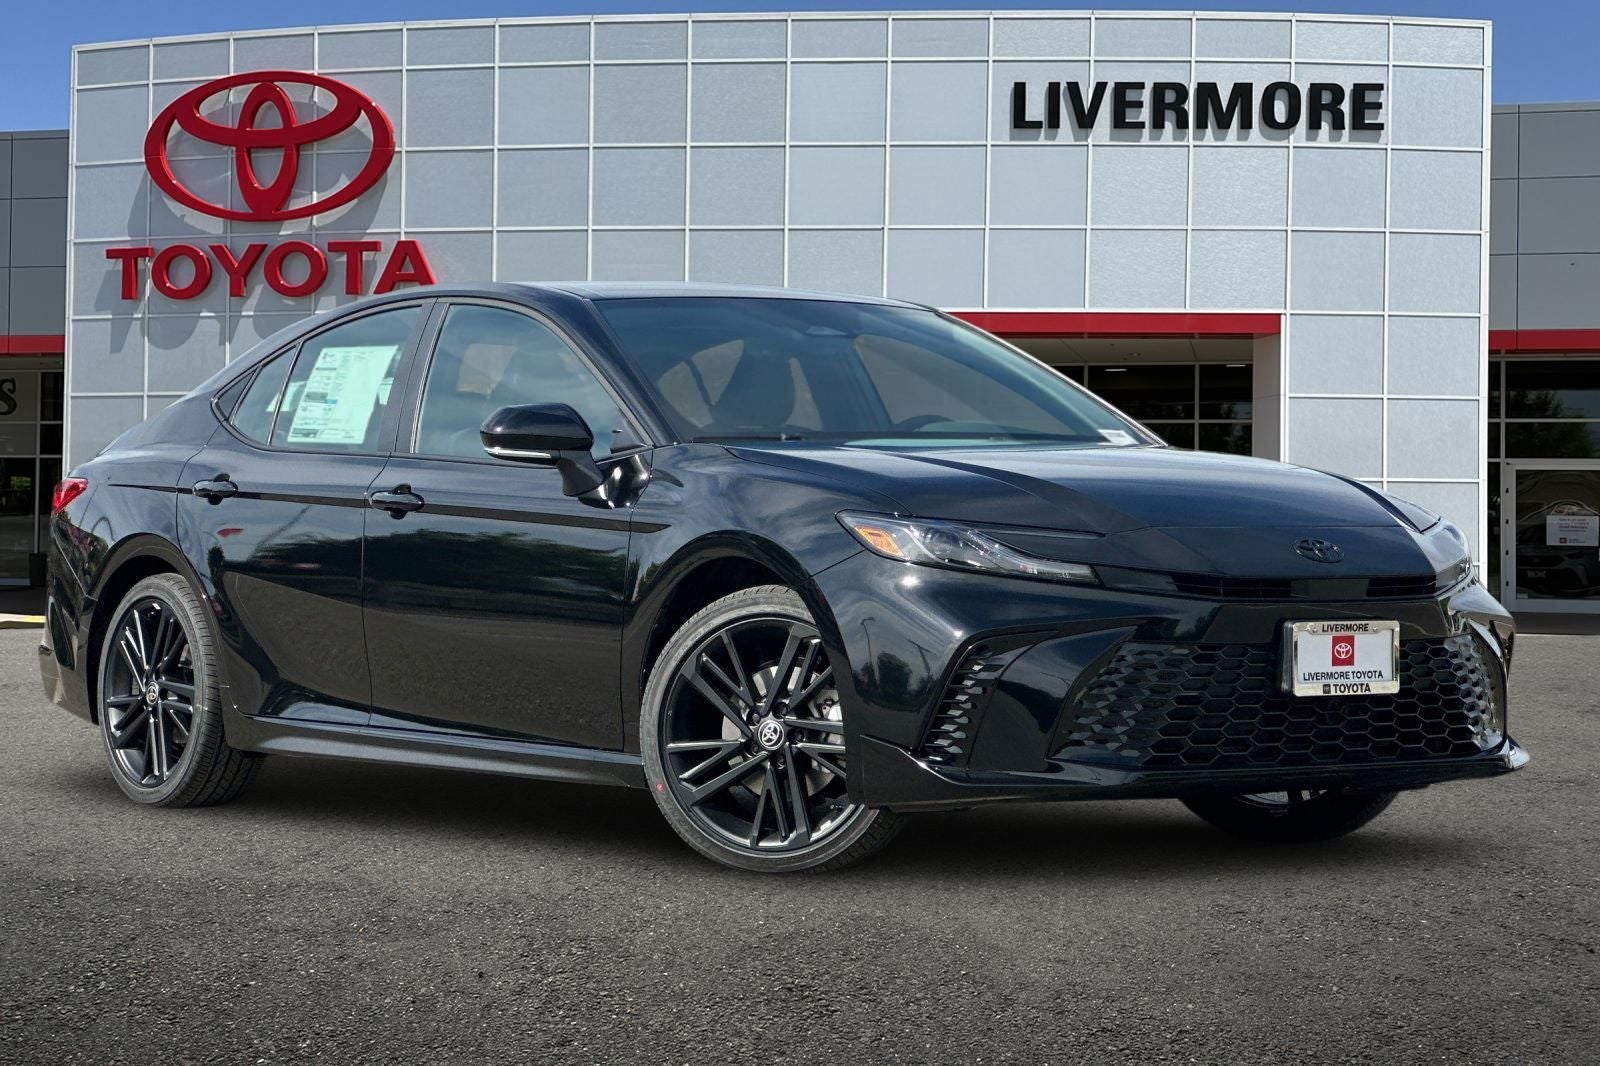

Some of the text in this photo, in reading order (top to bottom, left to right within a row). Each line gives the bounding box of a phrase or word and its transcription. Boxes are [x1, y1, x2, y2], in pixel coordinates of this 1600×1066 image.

[1012, 81, 1385, 131] LIVERMORE
[106, 239, 437, 300] TOYOTA
[1321, 623, 1369, 633] LIVERMORE
[1303, 670, 1384, 681] LIVERMORE TOYOTA
[1332, 682, 1371, 694] TOYOTA
